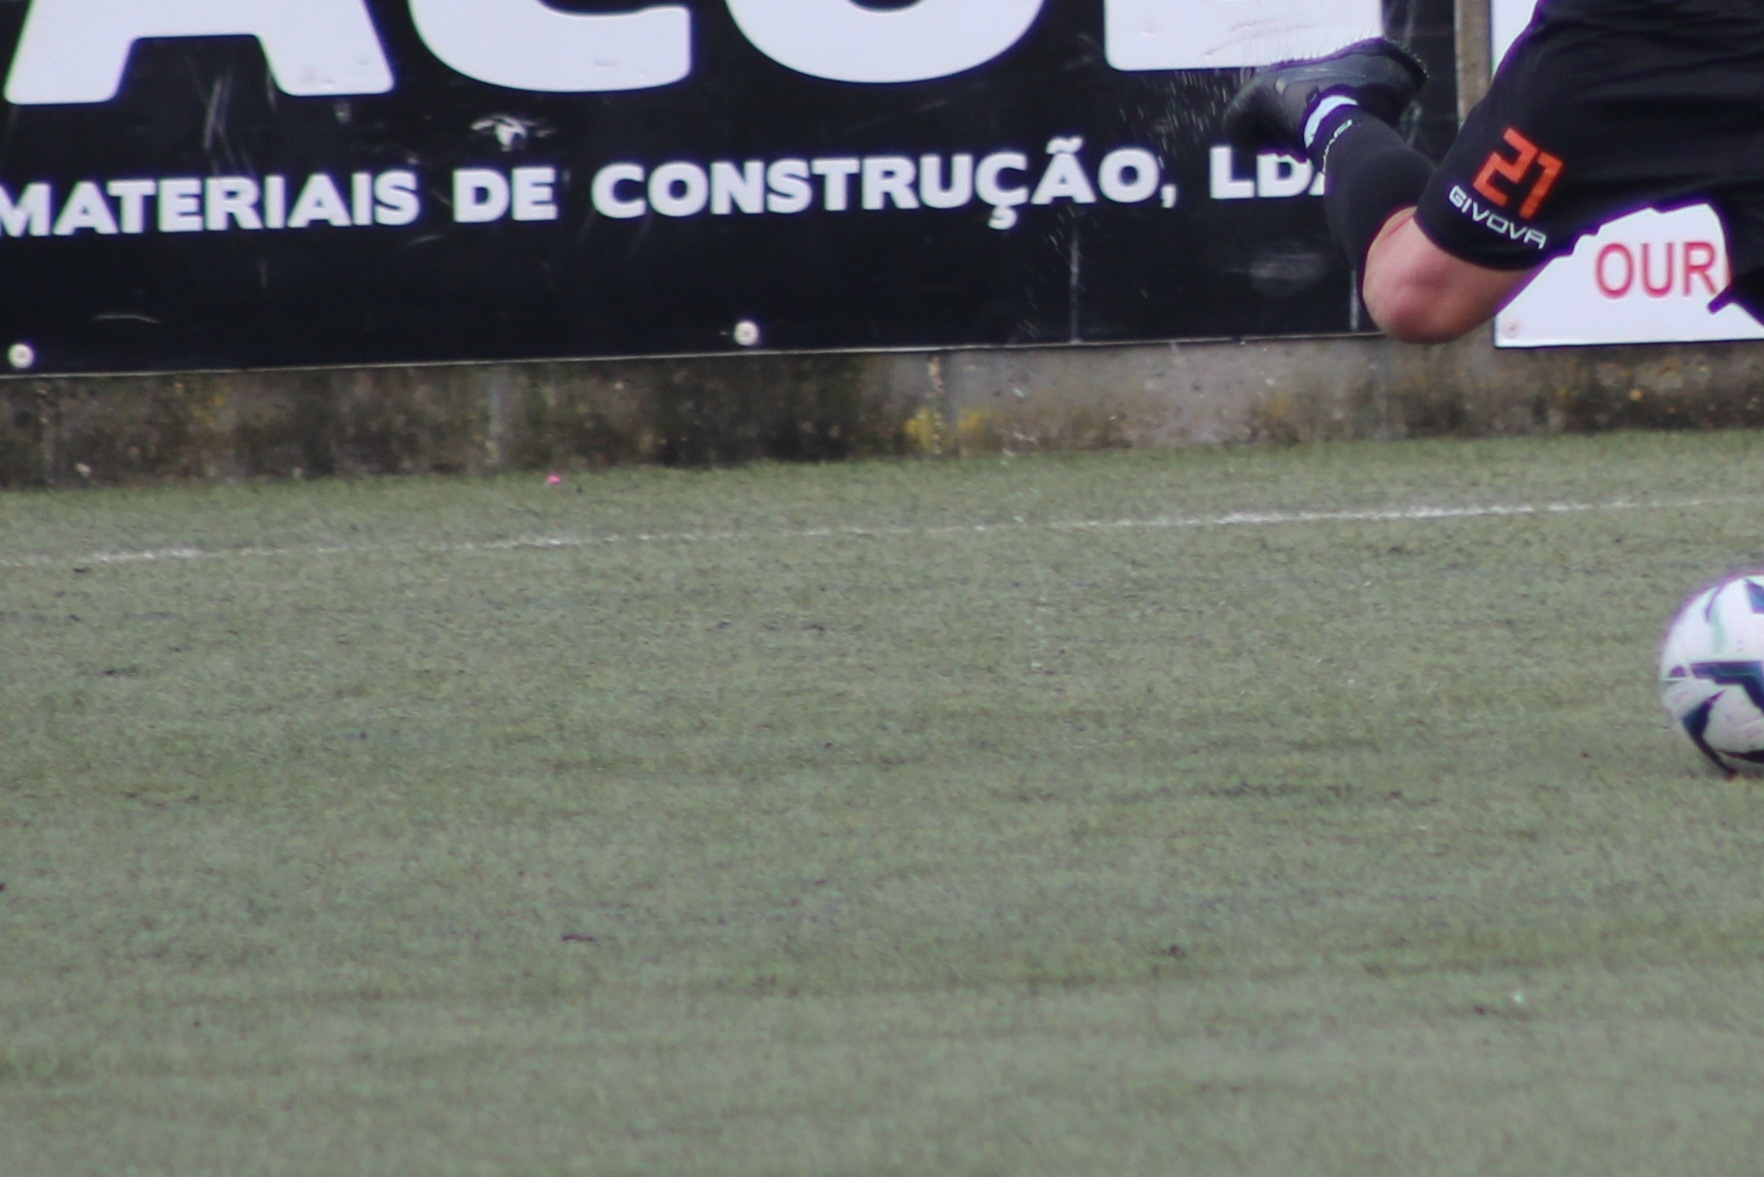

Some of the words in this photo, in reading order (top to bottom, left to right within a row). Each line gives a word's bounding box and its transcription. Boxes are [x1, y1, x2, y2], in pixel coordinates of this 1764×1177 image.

[0, 171, 421, 237] MATERIAIS
[451, 166, 558, 223] DE
[590, 136, 1178, 230] CONSTRUÇÃO,
[1210, 145, 1326, 199] LD
[1472, 127, 1563, 220] 21
[1448, 185, 1547, 249] GIVOVA
[1594, 240, 1720, 300] OUR
